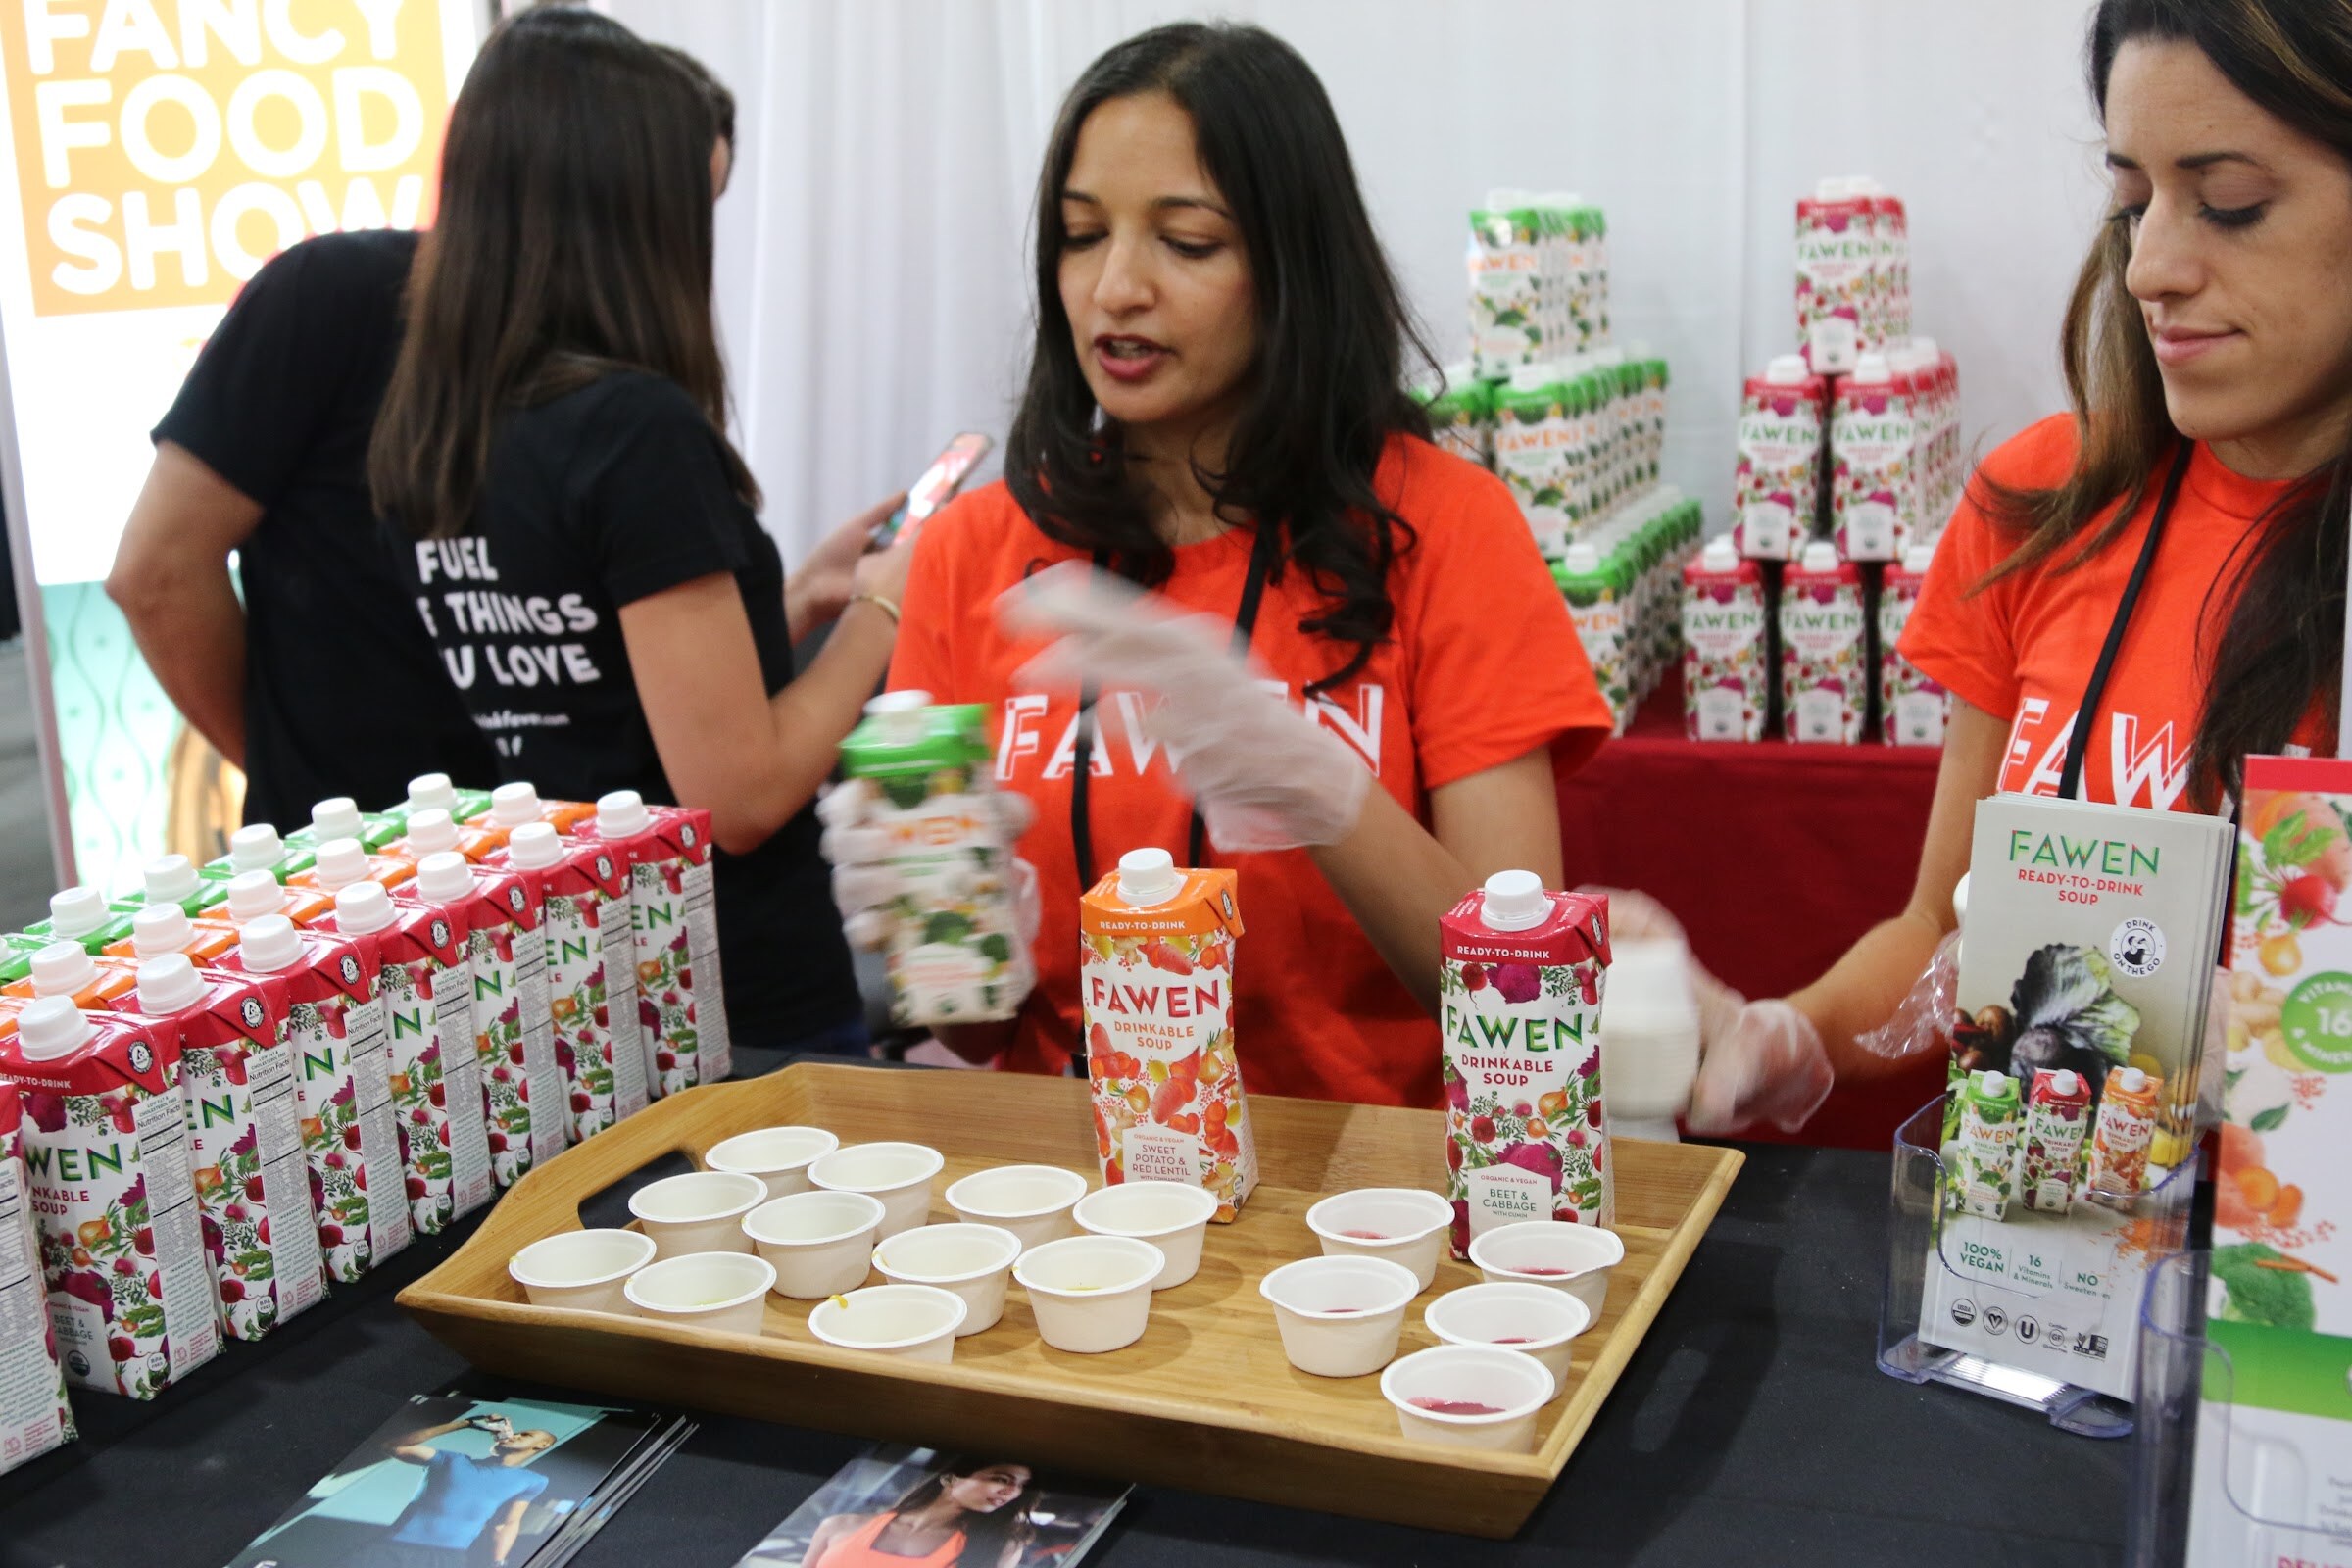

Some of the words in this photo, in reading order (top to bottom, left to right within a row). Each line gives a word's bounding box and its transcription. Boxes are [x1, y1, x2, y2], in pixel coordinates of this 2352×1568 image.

[24, 0, 404, 74] FANCY
[35, 67, 424, 188] FOOD
[47, 174, 423, 295] SHOW
[415, 536, 499, 584] FUEL
[444, 590, 598, 635] THINGS
[485, 644, 601, 686] LOVE
[2009, 828, 2161, 877] FAWEN
[2018, 868, 2144, 897] READY-TO-DRINK
[2058, 889, 2099, 906] SOUP
[1100, 920, 1186, 930] READY-TO-DRINK
[2125, 919, 2156, 932] DRINK
[1456, 945, 1550, 959] READY-TO-DRINK
[2113, 952, 2126, 968] ON
[2126, 964, 2145, 976] THE
[2147, 957, 2161, 972] GO
[1091, 976, 1221, 1019] FAWEN
[1113, 1021, 1195, 1037] DRINKABLE
[1446, 1004, 1584, 1053] FAWEN
[1137, 1036, 1172, 1051] SOUP
[249, 1065, 276, 1082] Nutrition
[274, 1058, 290, 1070] Facts
[1461, 1054, 1554, 1073] DRINKABLE
[1483, 1072, 1529, 1087] SOUP
[137, 1111, 166, 1129] Nutrition
[165, 1104, 181, 1116] Facts
[2100, 1109, 2150, 1137] FAWEN
[1964, 1118, 2015, 1144] FAWEN
[2035, 1116, 2084, 1141] FAWEN
[1142, 1144, 1176, 1154] SWEET
[24, 1142, 123, 1182] WEN
[1135, 1153, 1176, 1165] POTATO
[1179, 1157, 1186, 1166] &
[1132, 1163, 1153, 1174] RED
[1154, 1164, 1192, 1176] LENTIL
[1480, 1174, 1509, 1184] ORGANIC
[32, 1185, 90, 1203] NKABLE
[1490, 1188, 1518, 1200] BEET
[1521, 1191, 1529, 1200] &
[32, 1200, 68, 1216] SOUP
[1482, 1199, 1537, 1212] CABBAGE
[1963, 1241, 2002, 1261] 100%
[1960, 1252, 2005, 1274] VEGAN
[2029, 1254, 2042, 1268] 16
[2013, 1273, 2019, 1282] &
[2021, 1274, 2054, 1290] Minerals
[2018, 1264, 2051, 1280] Vitamins
[2076, 1272, 2099, 1287] NO
[54, 1325, 94, 1341] ABBAGE
[2021, 1320, 2034, 1339] U
